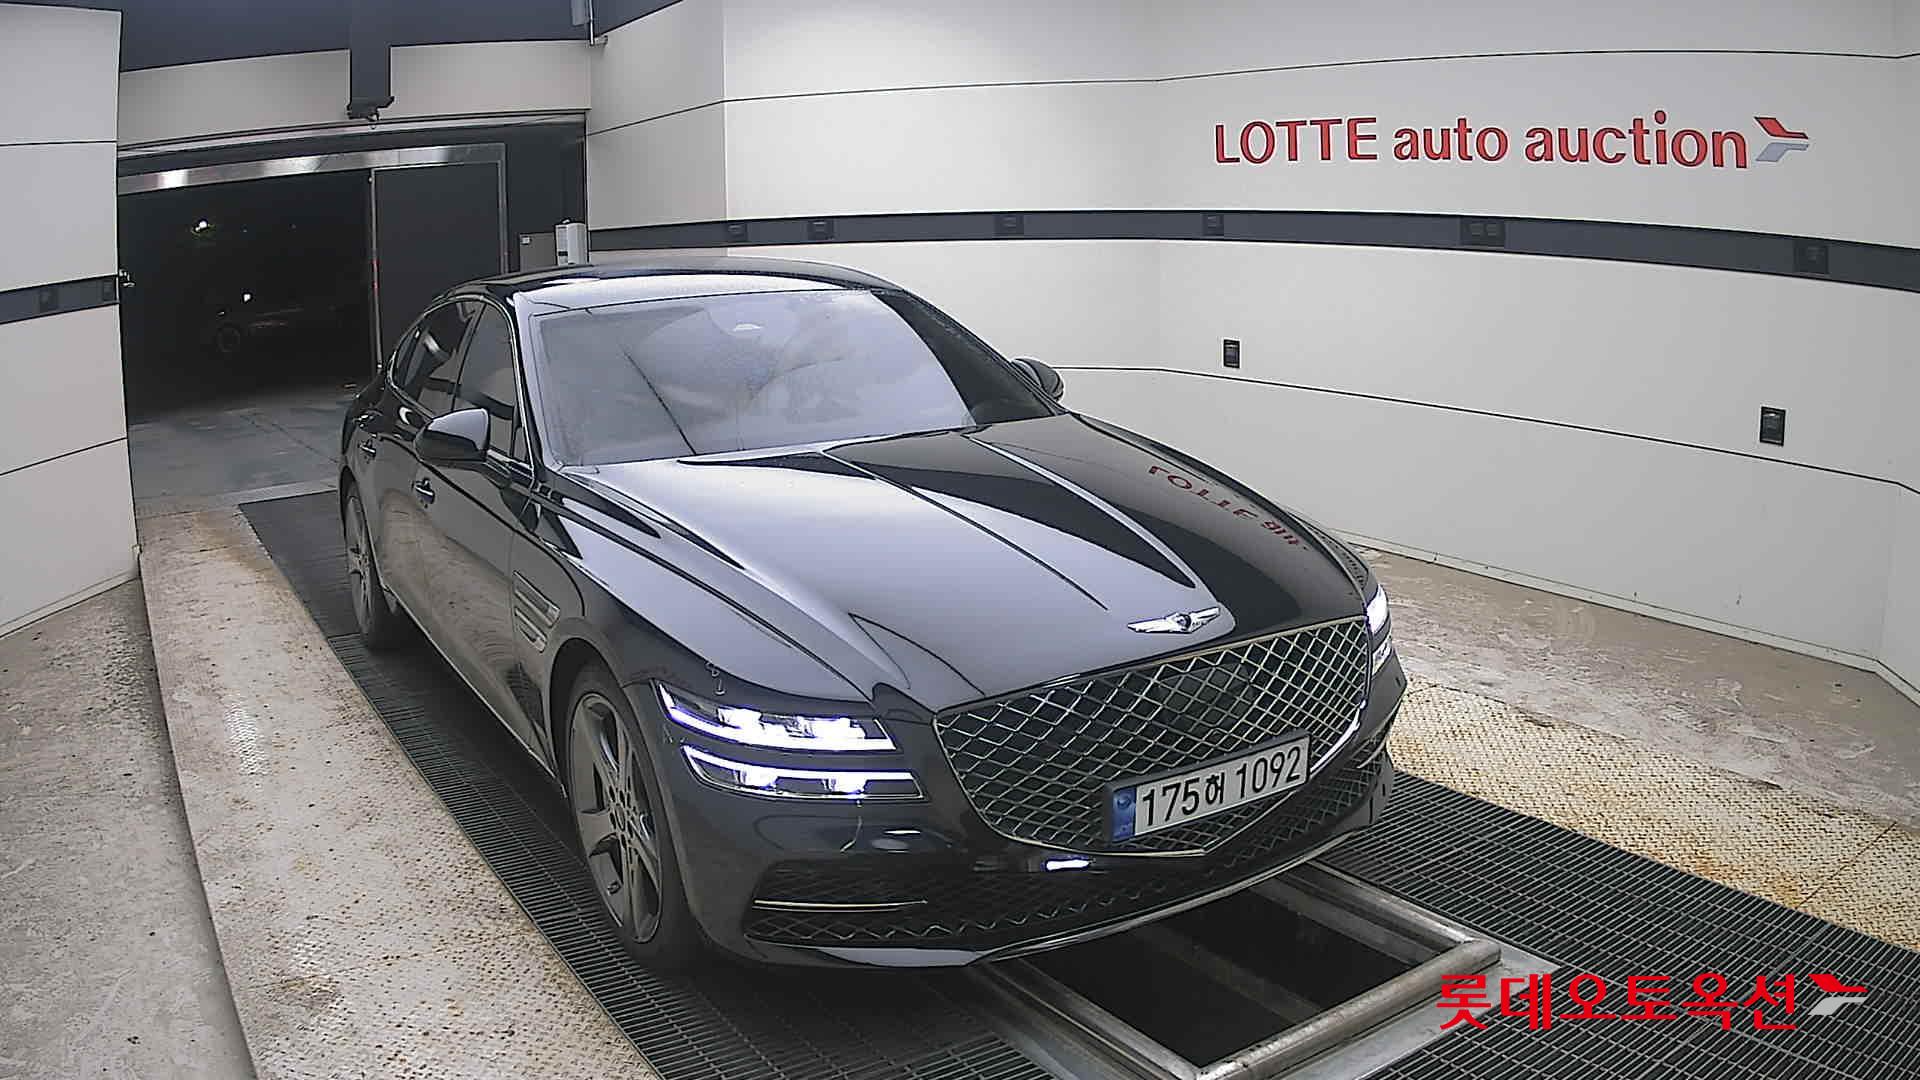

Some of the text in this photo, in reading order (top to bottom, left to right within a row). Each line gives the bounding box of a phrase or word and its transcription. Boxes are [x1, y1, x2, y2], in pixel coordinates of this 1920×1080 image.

[1215, 109, 1748, 169] LOTTE auto auction
[1142, 746, 1302, 827] 175허 1092
